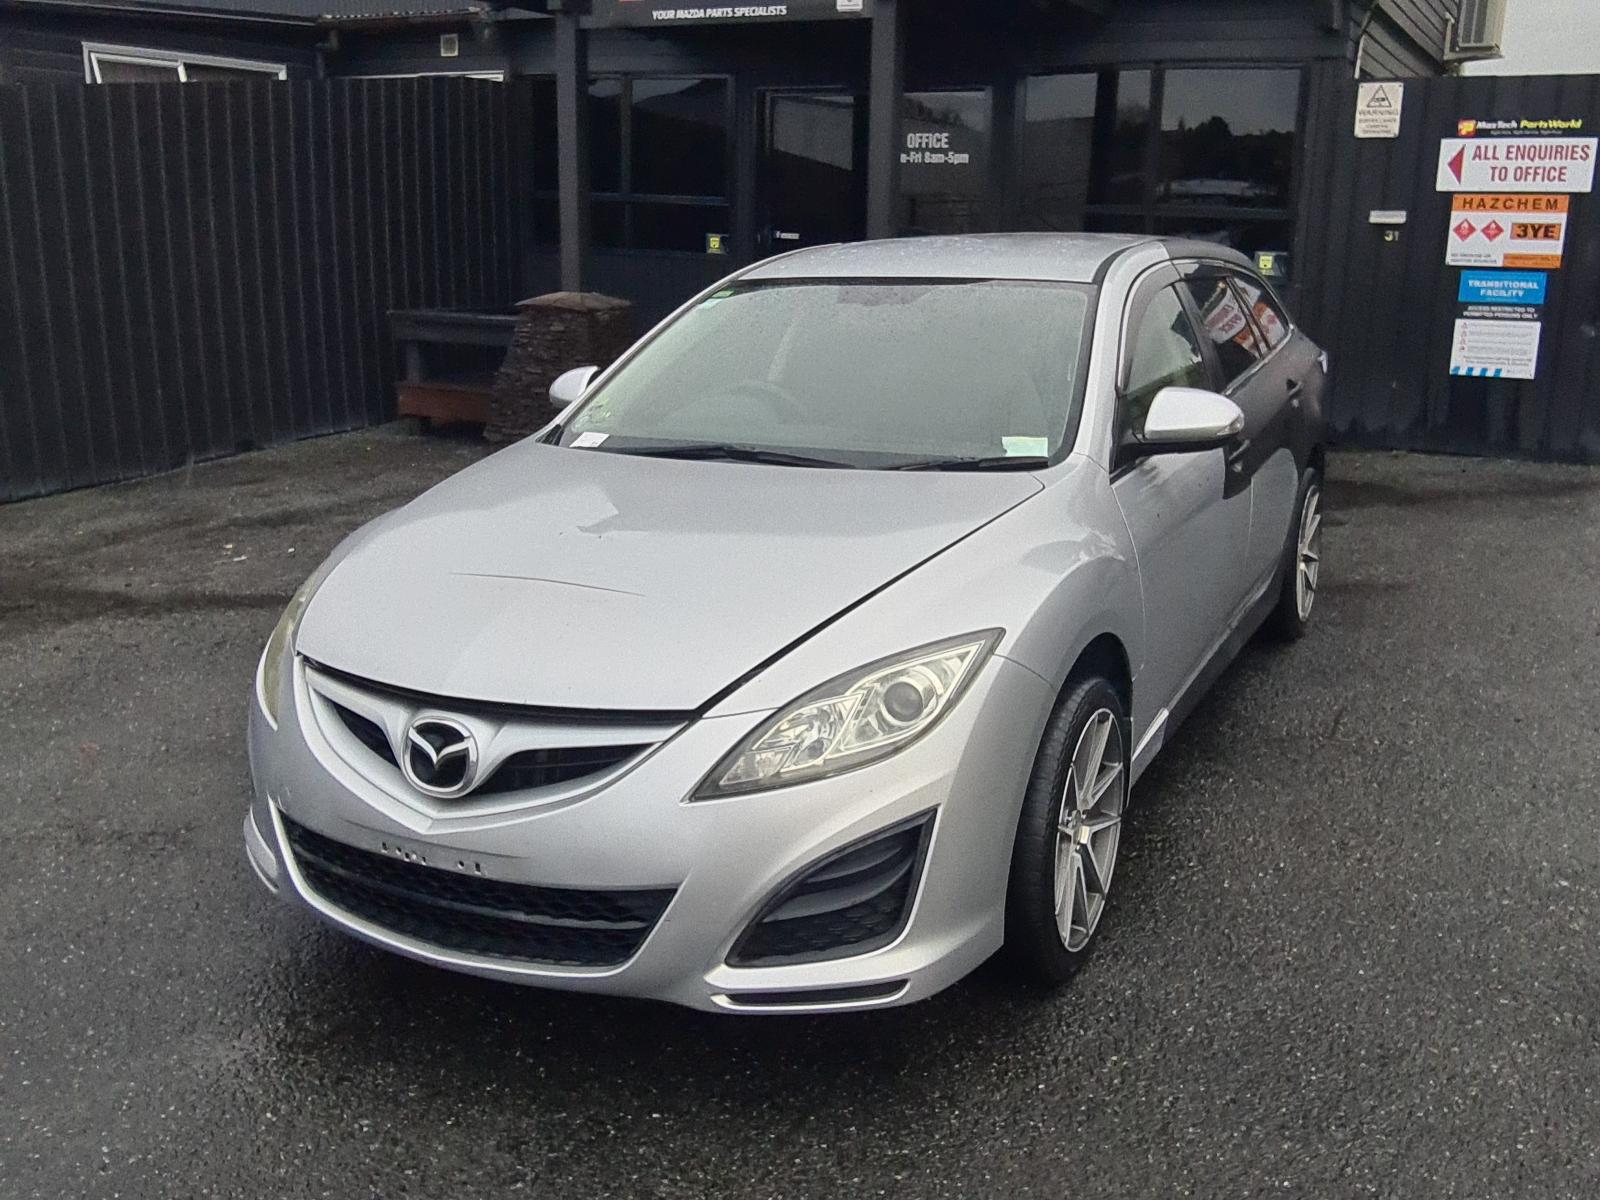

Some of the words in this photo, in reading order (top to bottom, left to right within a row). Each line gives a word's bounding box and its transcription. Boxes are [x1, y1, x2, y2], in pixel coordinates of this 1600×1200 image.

[652, 10, 676, 20] YOUR
[676, 9, 704, 19] MAZDA
[705, 8, 732, 18] PARTS
[733, 6, 788, 17] SPECIALISTS
[906, 132, 950, 149] OFFICE
[1471, 144, 1500, 161] ALL
[1505, 144, 1591, 162] ENQUIRIES
[1490, 166, 1508, 182] TO
[1513, 166, 1568, 183] OFFICE
[1462, 197, 1559, 210] HAZCHEM
[1516, 224, 1556, 239] 3YE
[1467, 279, 1539, 289] TRANSITIONAL
[1480, 289, 1525, 298] FACILITY
